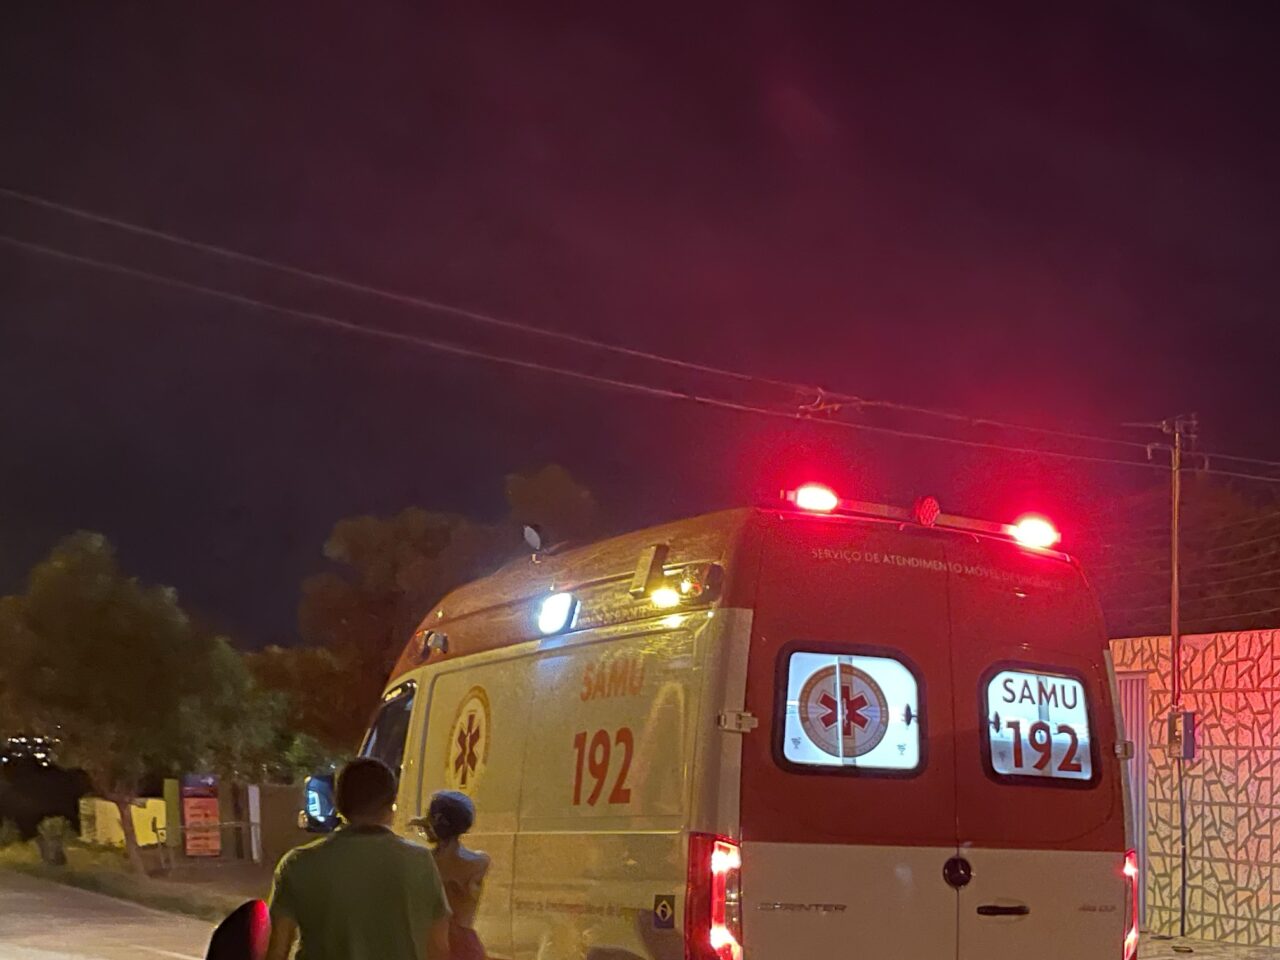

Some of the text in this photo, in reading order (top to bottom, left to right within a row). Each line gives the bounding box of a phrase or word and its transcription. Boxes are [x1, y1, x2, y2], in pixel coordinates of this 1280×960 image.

[811, 547, 861, 563] SERVIÇO
[865, 552, 880, 564] DE
[882, 555, 963, 574] ATENDIMENTO
[580, 657, 645, 702] SAMU
[1002, 678, 1078, 710] SAMU
[571, 726, 635, 806] 192
[1006, 720, 1083, 774] 192
